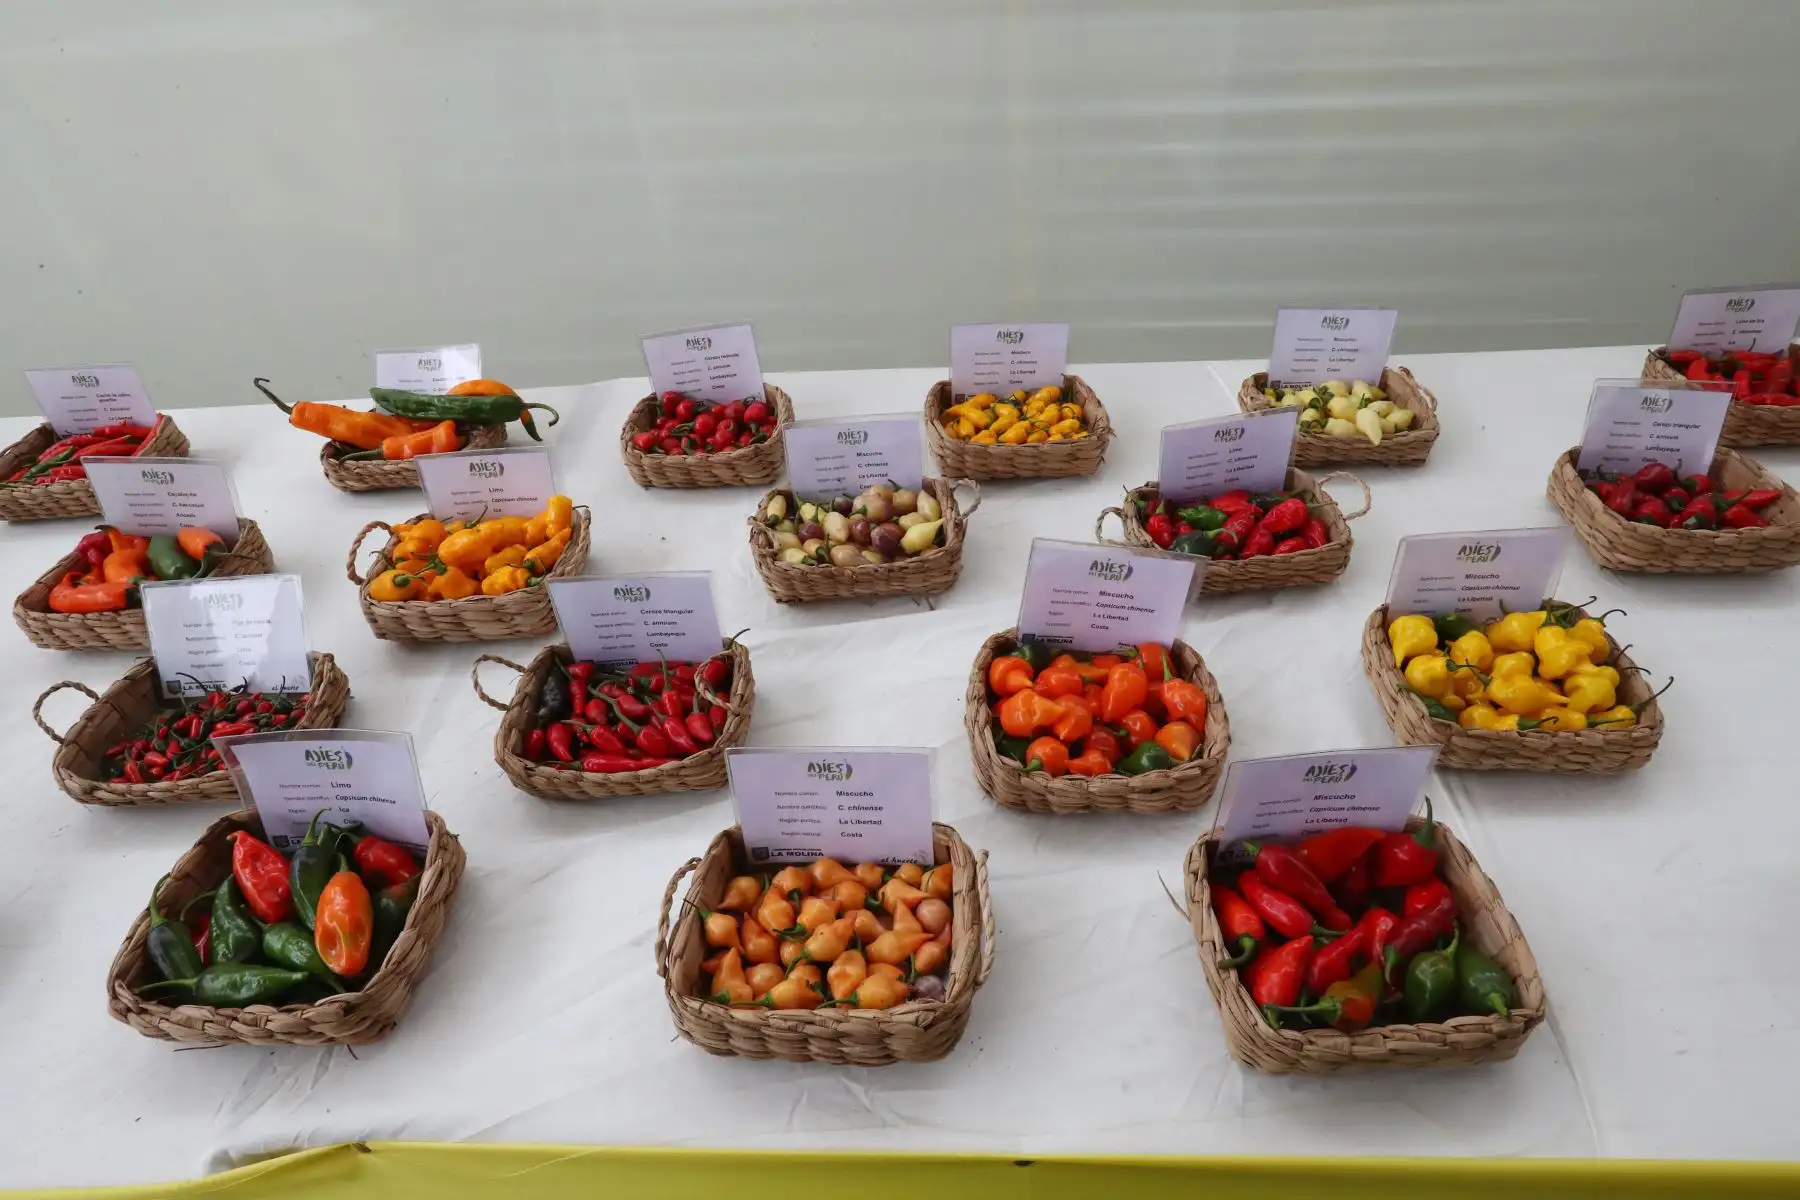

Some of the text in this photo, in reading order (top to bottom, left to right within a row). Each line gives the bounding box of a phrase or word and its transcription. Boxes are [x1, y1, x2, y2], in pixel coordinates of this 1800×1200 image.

[1099, 590, 1135, 599] Miscucho
[1095, 602, 1126, 610] Capsicum
[1126, 603, 1156, 614] chinense
[331, 781, 352, 789] Limo
[369, 796, 397, 804] chinense
